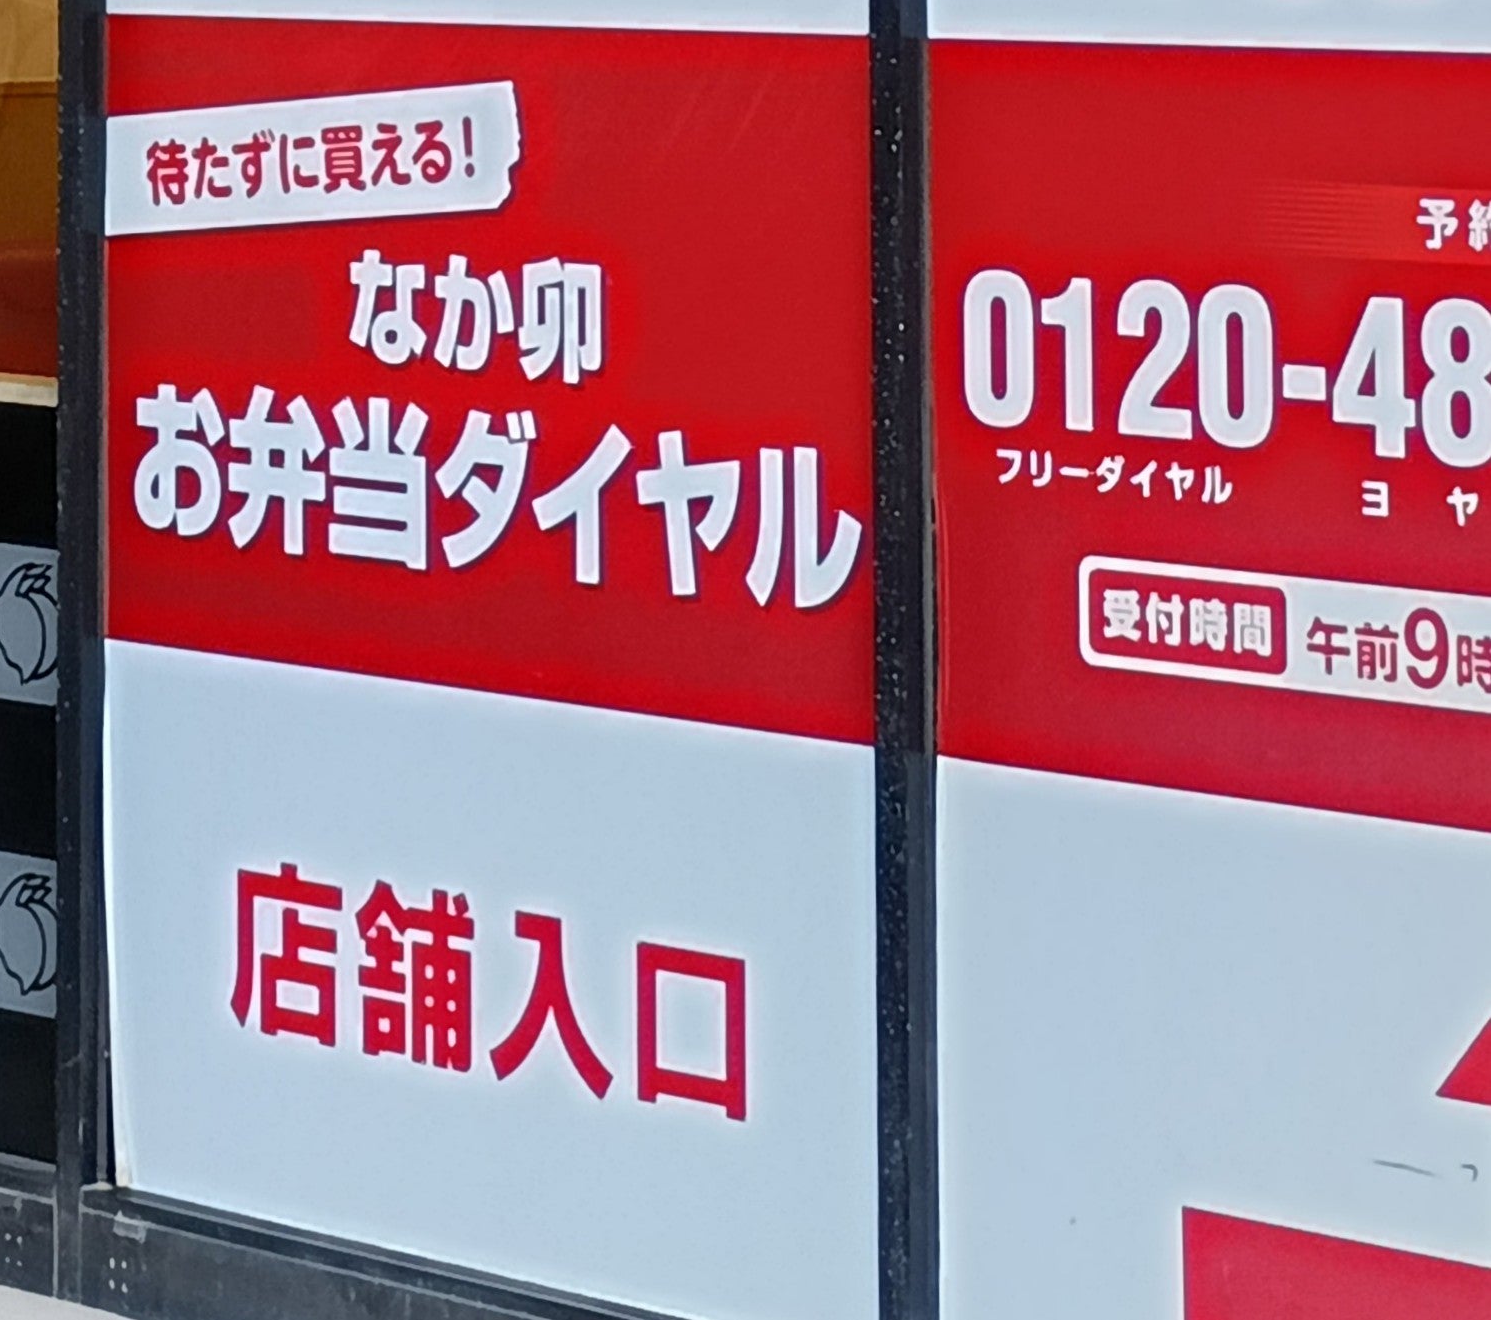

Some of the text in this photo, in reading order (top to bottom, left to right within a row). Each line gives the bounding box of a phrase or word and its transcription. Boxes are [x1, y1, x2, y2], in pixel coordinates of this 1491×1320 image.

[349, 248, 603, 385] なか卯
[963, 268, 1491, 469] 0120-48
[133, 383, 863, 609] お弁当ダイヤル
[995, 449, 1234, 505] フリーダイヤル
[1102, 588, 1273, 658] 受付時間
[1305, 606, 1491, 692] 午前9時
[230, 862, 747, 1122] 店舗入口
